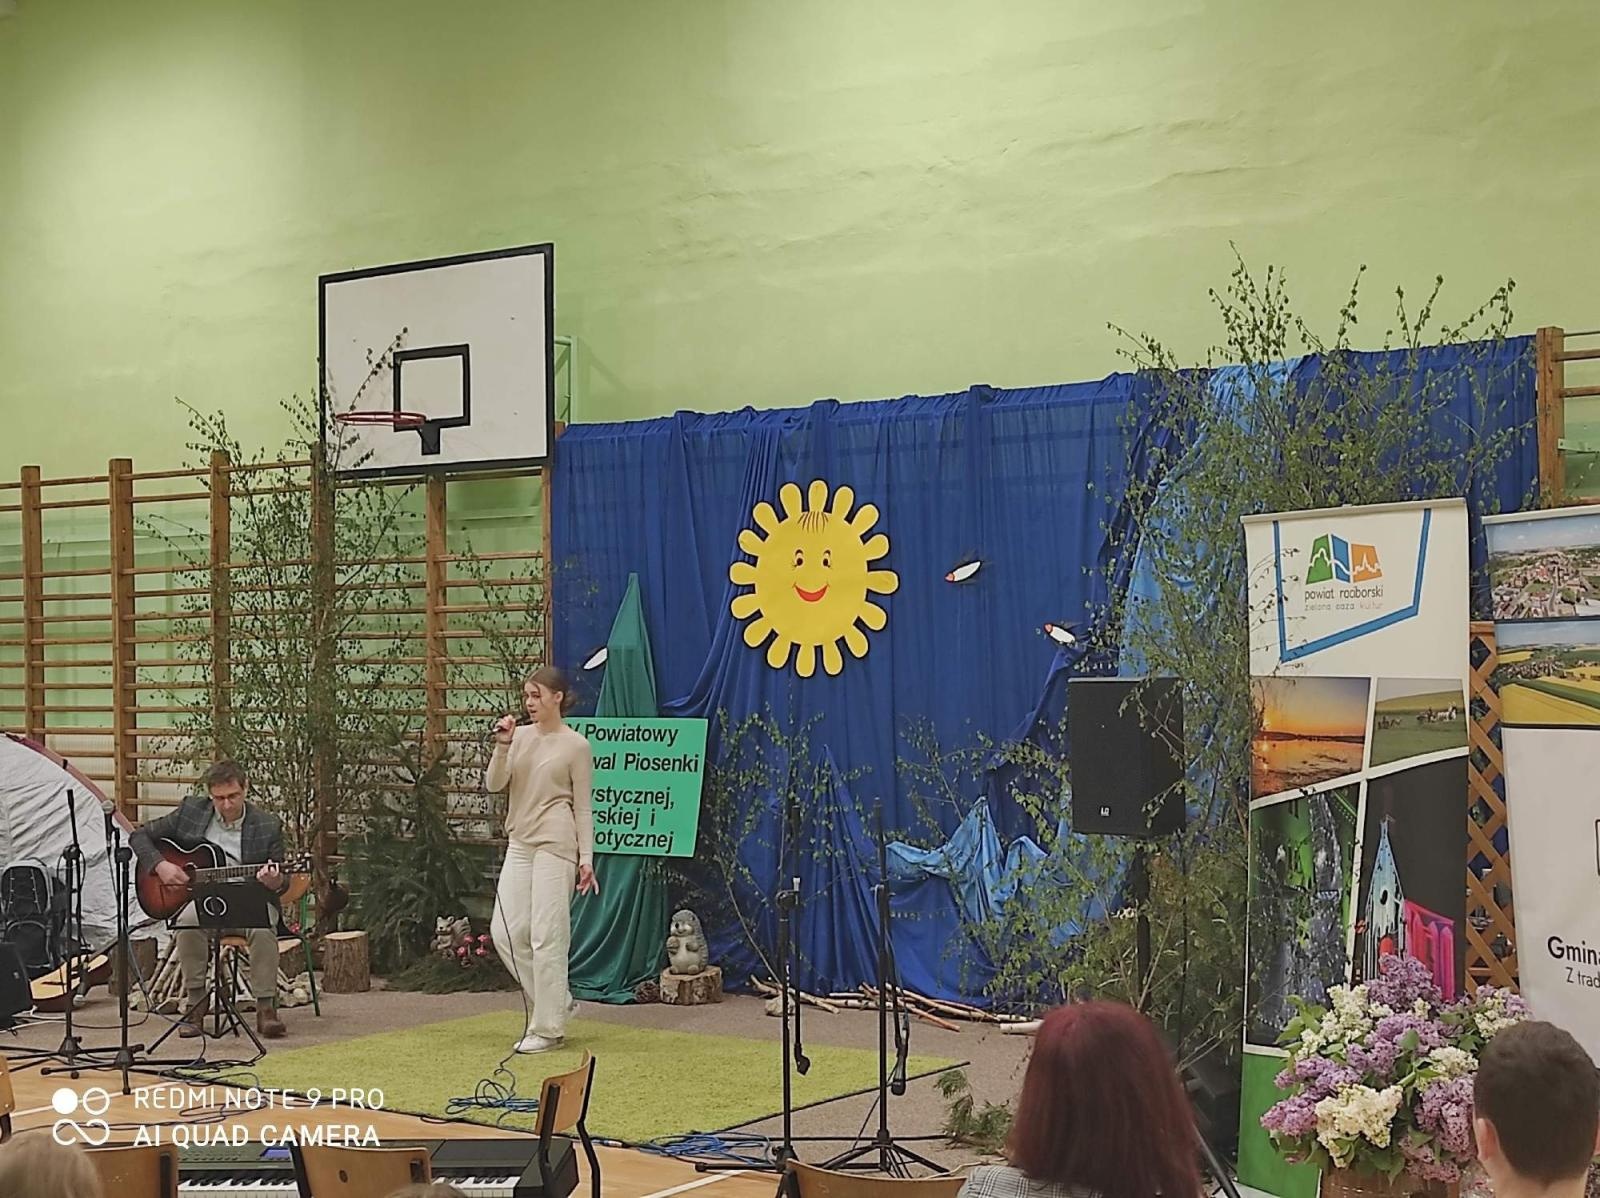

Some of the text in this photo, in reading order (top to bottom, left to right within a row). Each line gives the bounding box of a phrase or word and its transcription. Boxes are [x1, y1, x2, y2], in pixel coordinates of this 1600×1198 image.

[585, 723, 679, 747] Powiatowy
[624, 753, 699, 773] Piosenki
[650, 809, 656, 827] i
[1548, 936, 1600, 966] Gmin
[1565, 966, 1574, 984] Z
